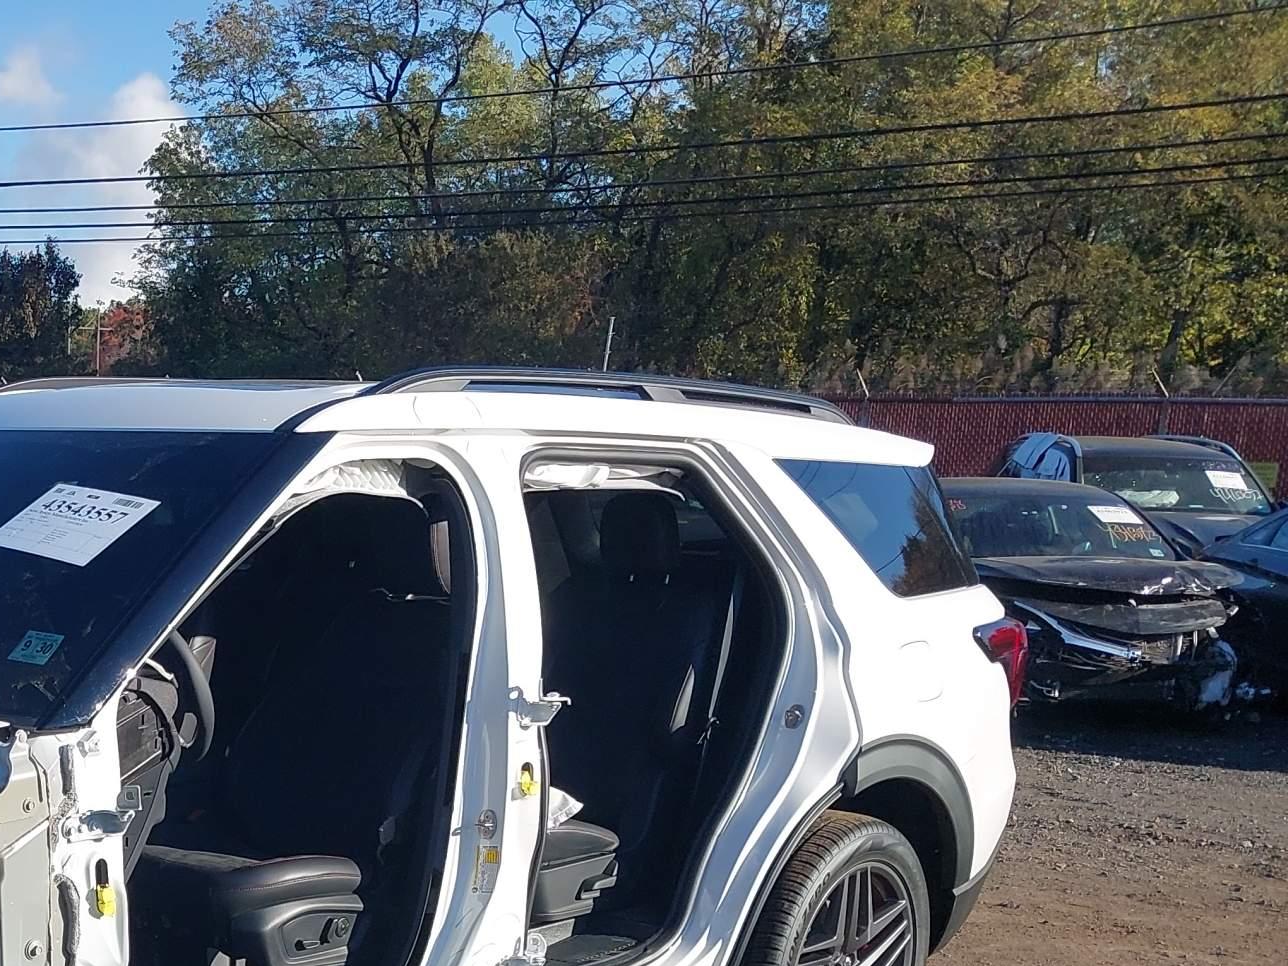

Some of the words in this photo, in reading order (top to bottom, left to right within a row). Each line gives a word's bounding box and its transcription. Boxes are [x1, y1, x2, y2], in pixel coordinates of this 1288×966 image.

[41, 498, 130, 524] 43543557
[21, 639, 33, 652] 9
[35, 642, 54, 655] 30
